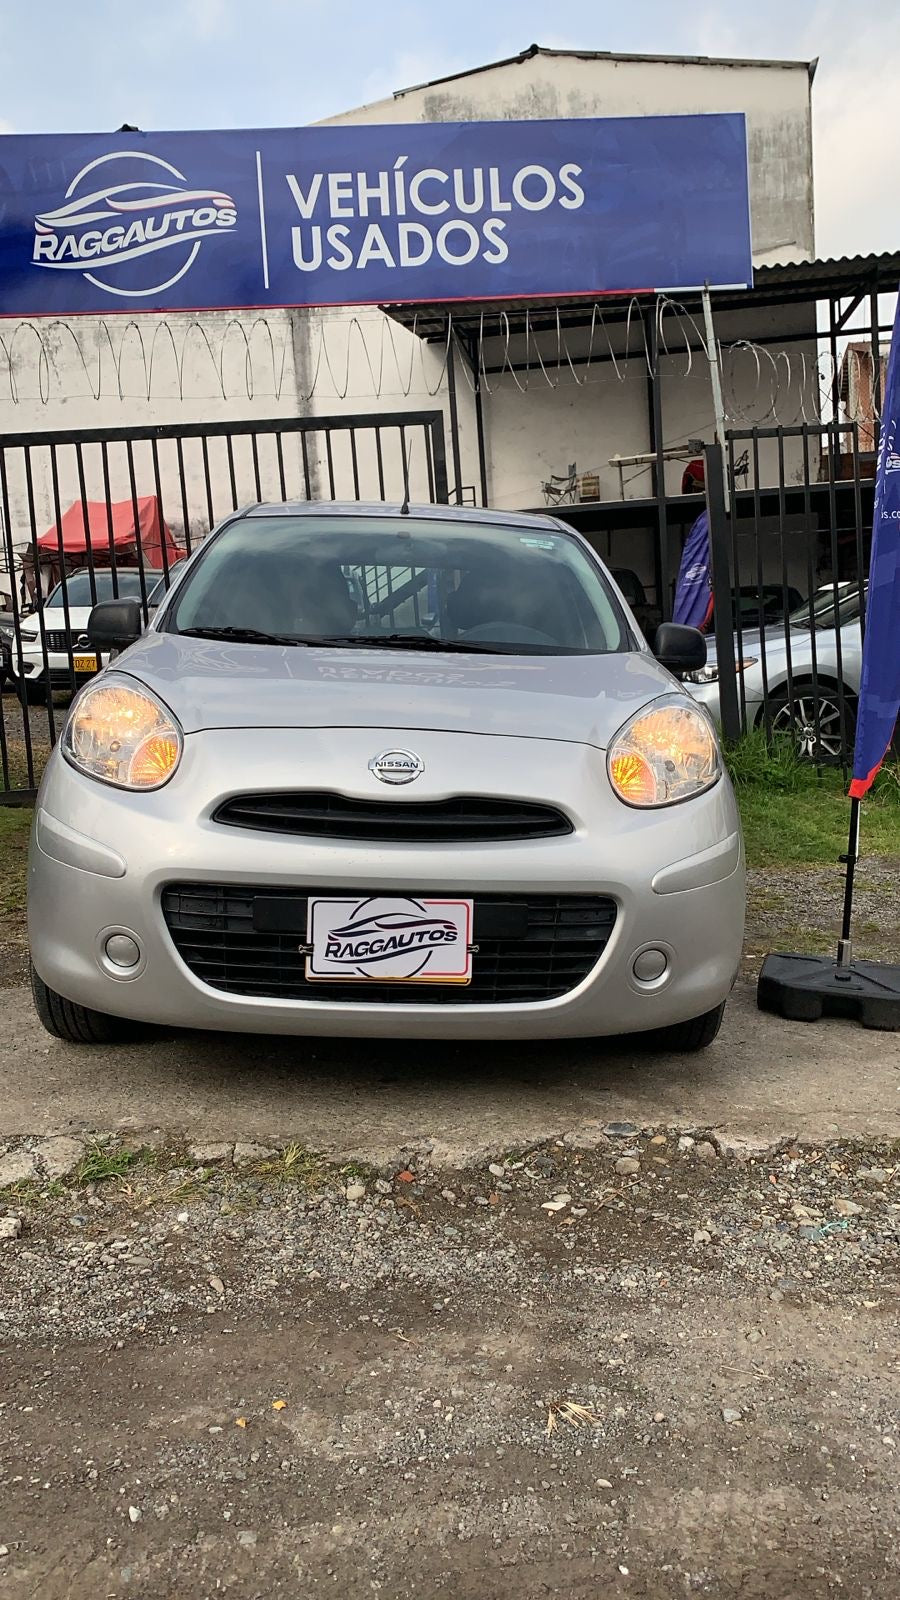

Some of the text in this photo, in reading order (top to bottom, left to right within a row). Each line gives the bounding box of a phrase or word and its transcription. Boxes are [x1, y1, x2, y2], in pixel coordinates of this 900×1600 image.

[286, 155, 585, 219] VEHÍCULOS
[32, 207, 238, 261] RAGGAUTOS
[291, 217, 509, 272] USADOS
[375, 761, 419, 769] NISSAN
[324, 930, 458, 959] RAGGAUTOS
